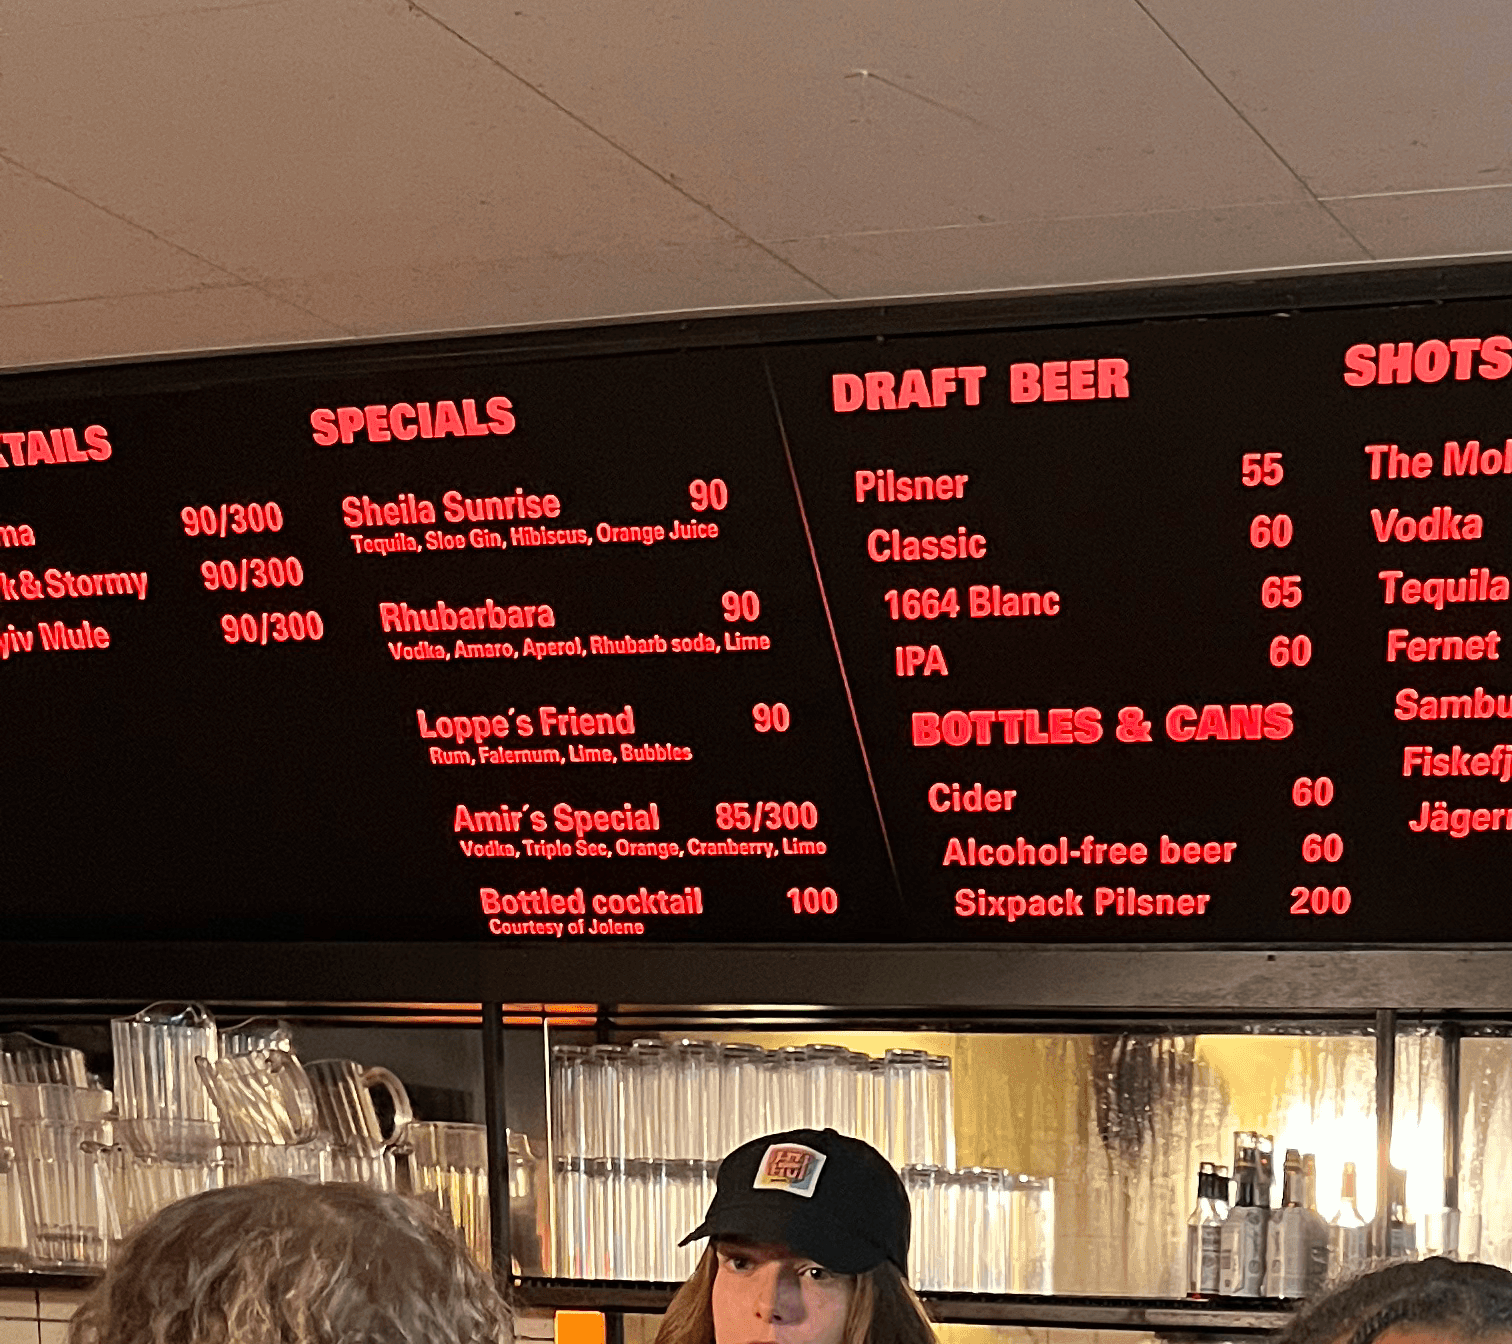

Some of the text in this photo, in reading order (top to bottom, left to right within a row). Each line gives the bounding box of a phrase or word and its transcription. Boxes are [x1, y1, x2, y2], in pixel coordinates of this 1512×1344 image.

[1344, 336, 1512, 386] SHOTS
[833, 359, 1129, 412] DRAFT BEER
[311, 397, 515, 446] SPECIALS
[1242, 453, 1283, 486] 55
[1365, 445, 1432, 480] The
[689, 479, 728, 512] 90
[856, 470, 968, 502] Pilsner
[181, 502, 283, 538] 90/300
[342, 488, 560, 528] Sheila Sunrise
[1370, 506, 1482, 542] Vodka
[350, 532, 422, 556] Tequila,
[468, 529, 506, 549] Gin,
[510, 526, 592, 546] Hibiscus,
[596, 522, 664, 545] Orange
[669, 520, 718, 540] Juice
[868, 527, 986, 562] Classic
[1250, 514, 1292, 548] 60
[200, 556, 303, 592] 90/300
[1378, 568, 1509, 610] Tequila
[722, 591, 759, 622] 90
[884, 585, 1060, 620] 1664 Blanc
[1262, 576, 1302, 608] 65
[221, 611, 323, 645] 90/300
[379, 599, 555, 632] Rhubarbara
[38, 620, 110, 650] Mule
[388, 632, 770, 660] Vodka, Amaro, Aperol, Rhubarb soda, Lime
[1270, 635, 1311, 668] 60
[1387, 629, 1501, 662] Fernet
[896, 645, 948, 676] IPA
[539, 705, 635, 736] Friend
[752, 703, 790, 732] 90
[912, 703, 1293, 746] BOTTLES & CANS
[429, 747, 476, 766] Rum,
[568, 744, 617, 764] Lime,
[621, 743, 692, 762] Bubbles
[928, 783, 1016, 812] Cider
[1292, 777, 1333, 806] 60
[554, 803, 659, 838] Special
[716, 801, 817, 832] 85/300
[460, 840, 520, 858] Vodka,
[616, 839, 682, 860] Orange,
[687, 838, 778, 858] Cranberry,
[782, 838, 826, 854] Lime
[943, 835, 1236, 866] Alcohol-free beer
[1302, 834, 1343, 862] 60
[480, 887, 702, 915] Bottled cocktail
[787, 887, 838, 914] 100
[955, 887, 1210, 922] Sixpack Pilsner
[1290, 887, 1351, 914] 200
[489, 918, 644, 938] Courtesy of Jolene
